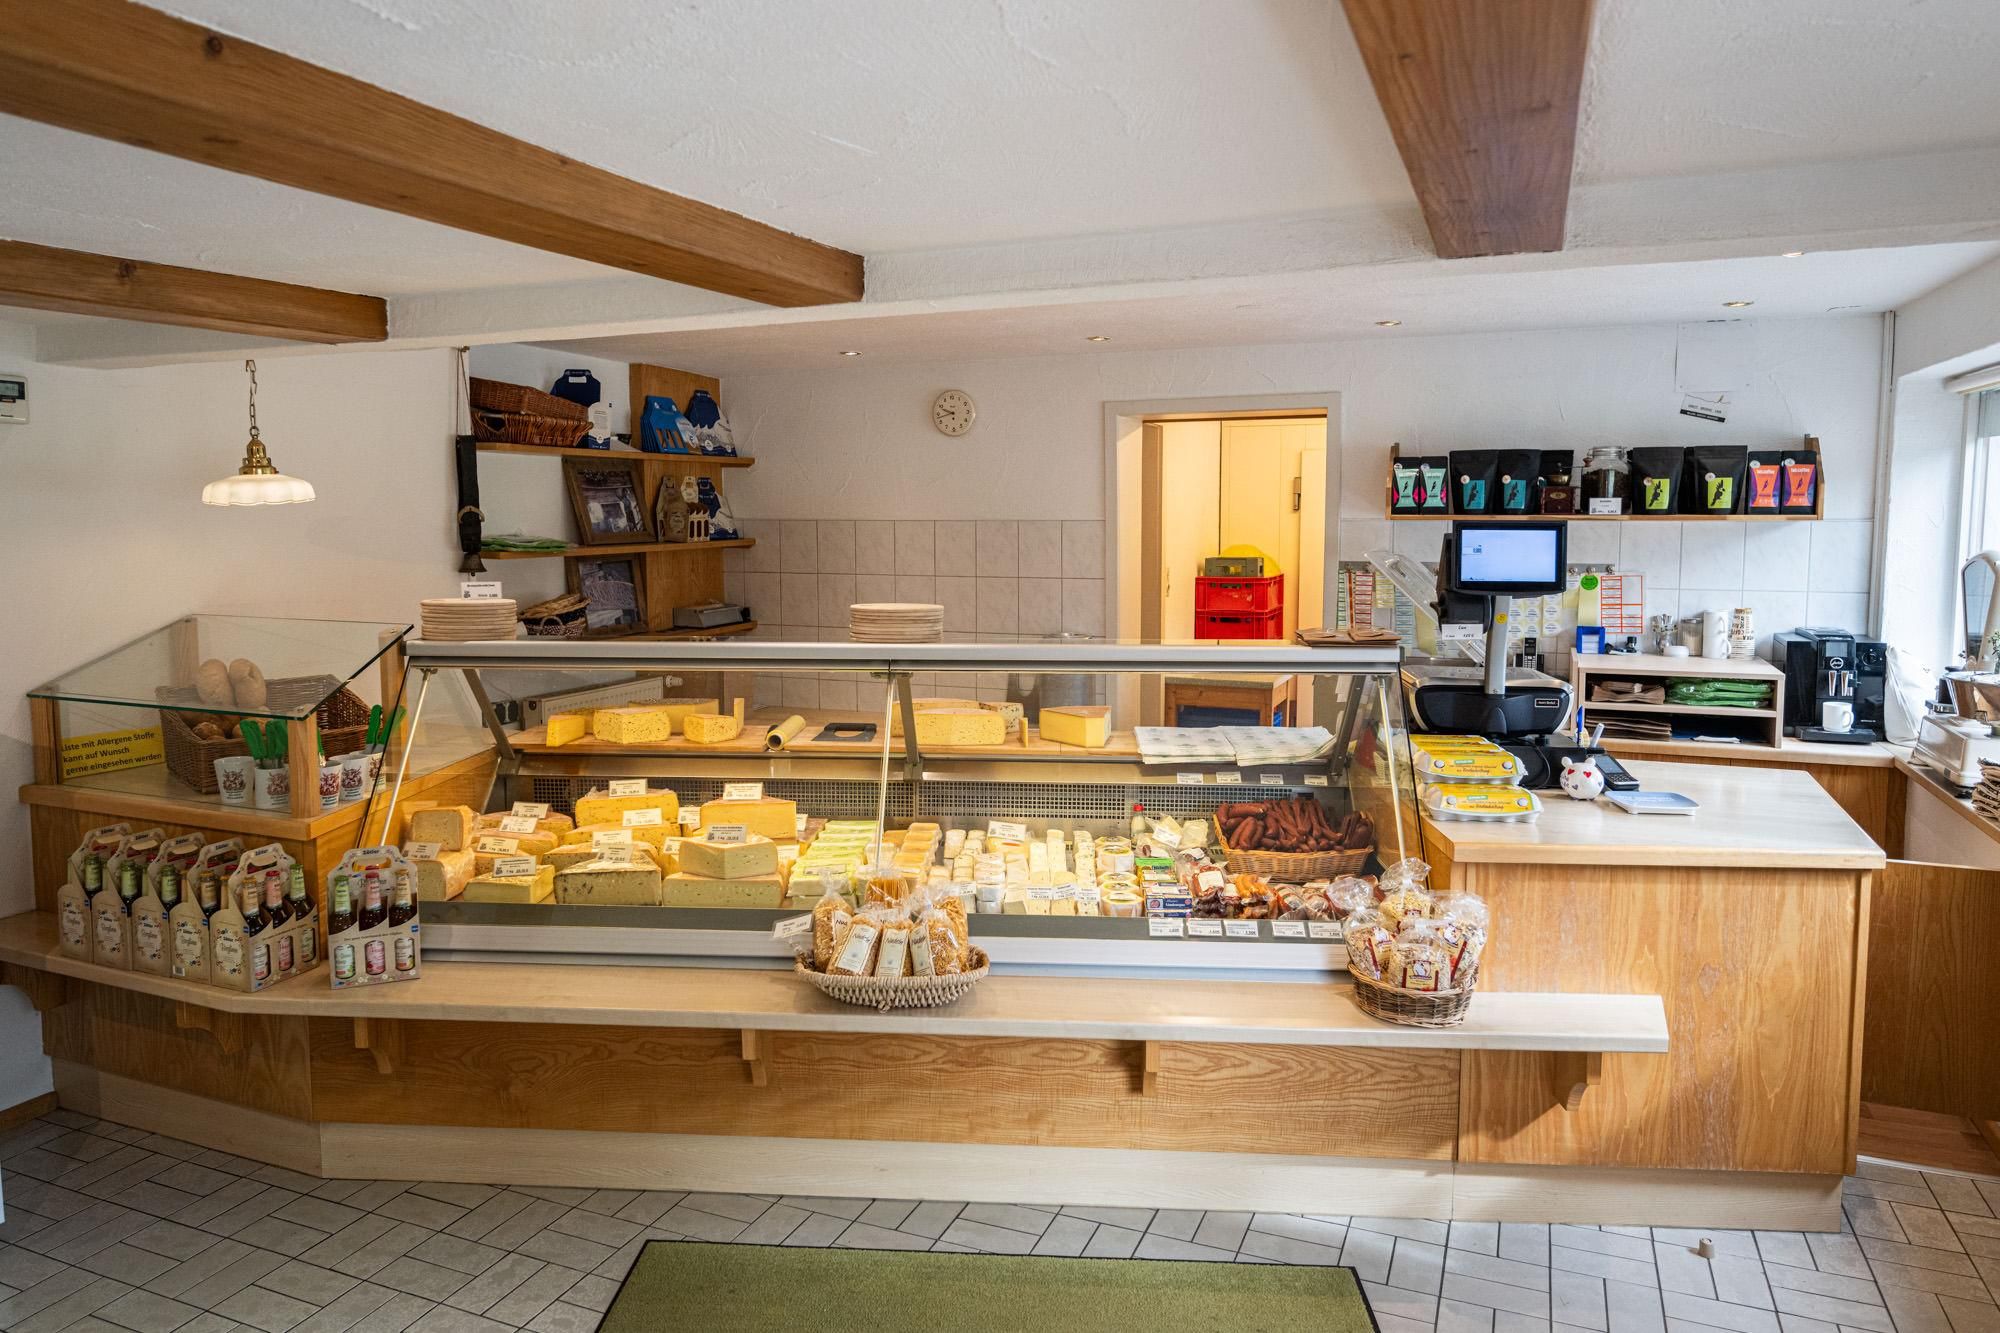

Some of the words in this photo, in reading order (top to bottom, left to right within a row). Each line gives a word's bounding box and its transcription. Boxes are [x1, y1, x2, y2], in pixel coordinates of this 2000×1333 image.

[81, 741, 95, 749] mit
[97, 736, 132, 746] Allergene
[133, 731, 155, 741] Stoffe
[63, 755, 84, 763] kann
[85, 751, 98, 760] auf
[99, 747, 130, 757] Wunsch
[66, 765, 89, 775] gerne
[90, 757, 134, 769] eingesehen
[135, 752, 162, 762] werden
